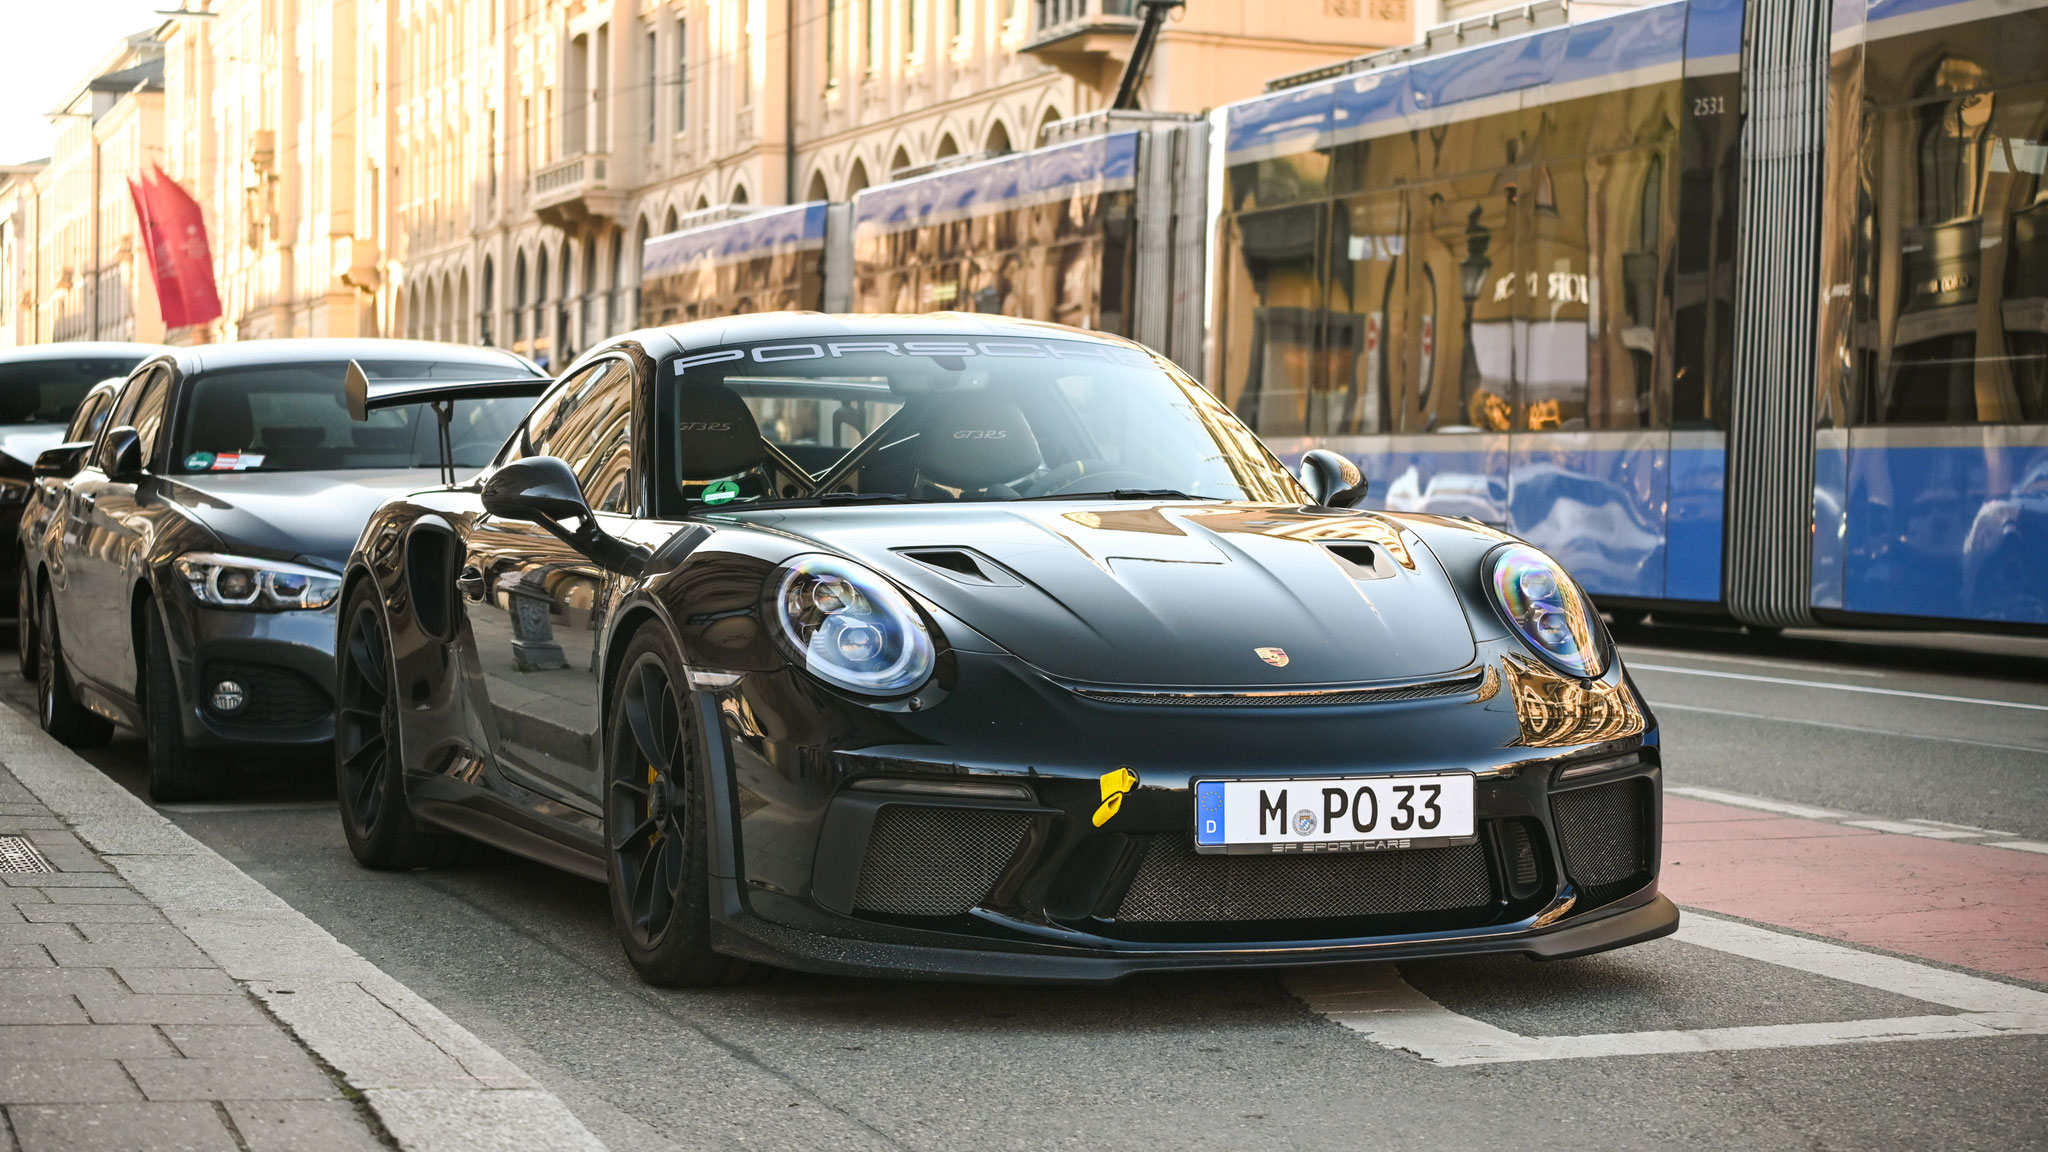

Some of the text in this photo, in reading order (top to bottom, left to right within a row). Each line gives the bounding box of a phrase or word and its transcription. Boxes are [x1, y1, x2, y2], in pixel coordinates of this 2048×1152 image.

[1694, 96, 1725, 116] 2531
[673, 342, 1162, 376] PORSCHE
[716, 482, 727, 493] 4
[1259, 789, 1288, 836] M
[1321, 786, 1379, 834] PO
[1390, 784, 1442, 832] 33
[1206, 820, 1217, 834] D
[1302, 838, 1412, 853] SPORTCARS
